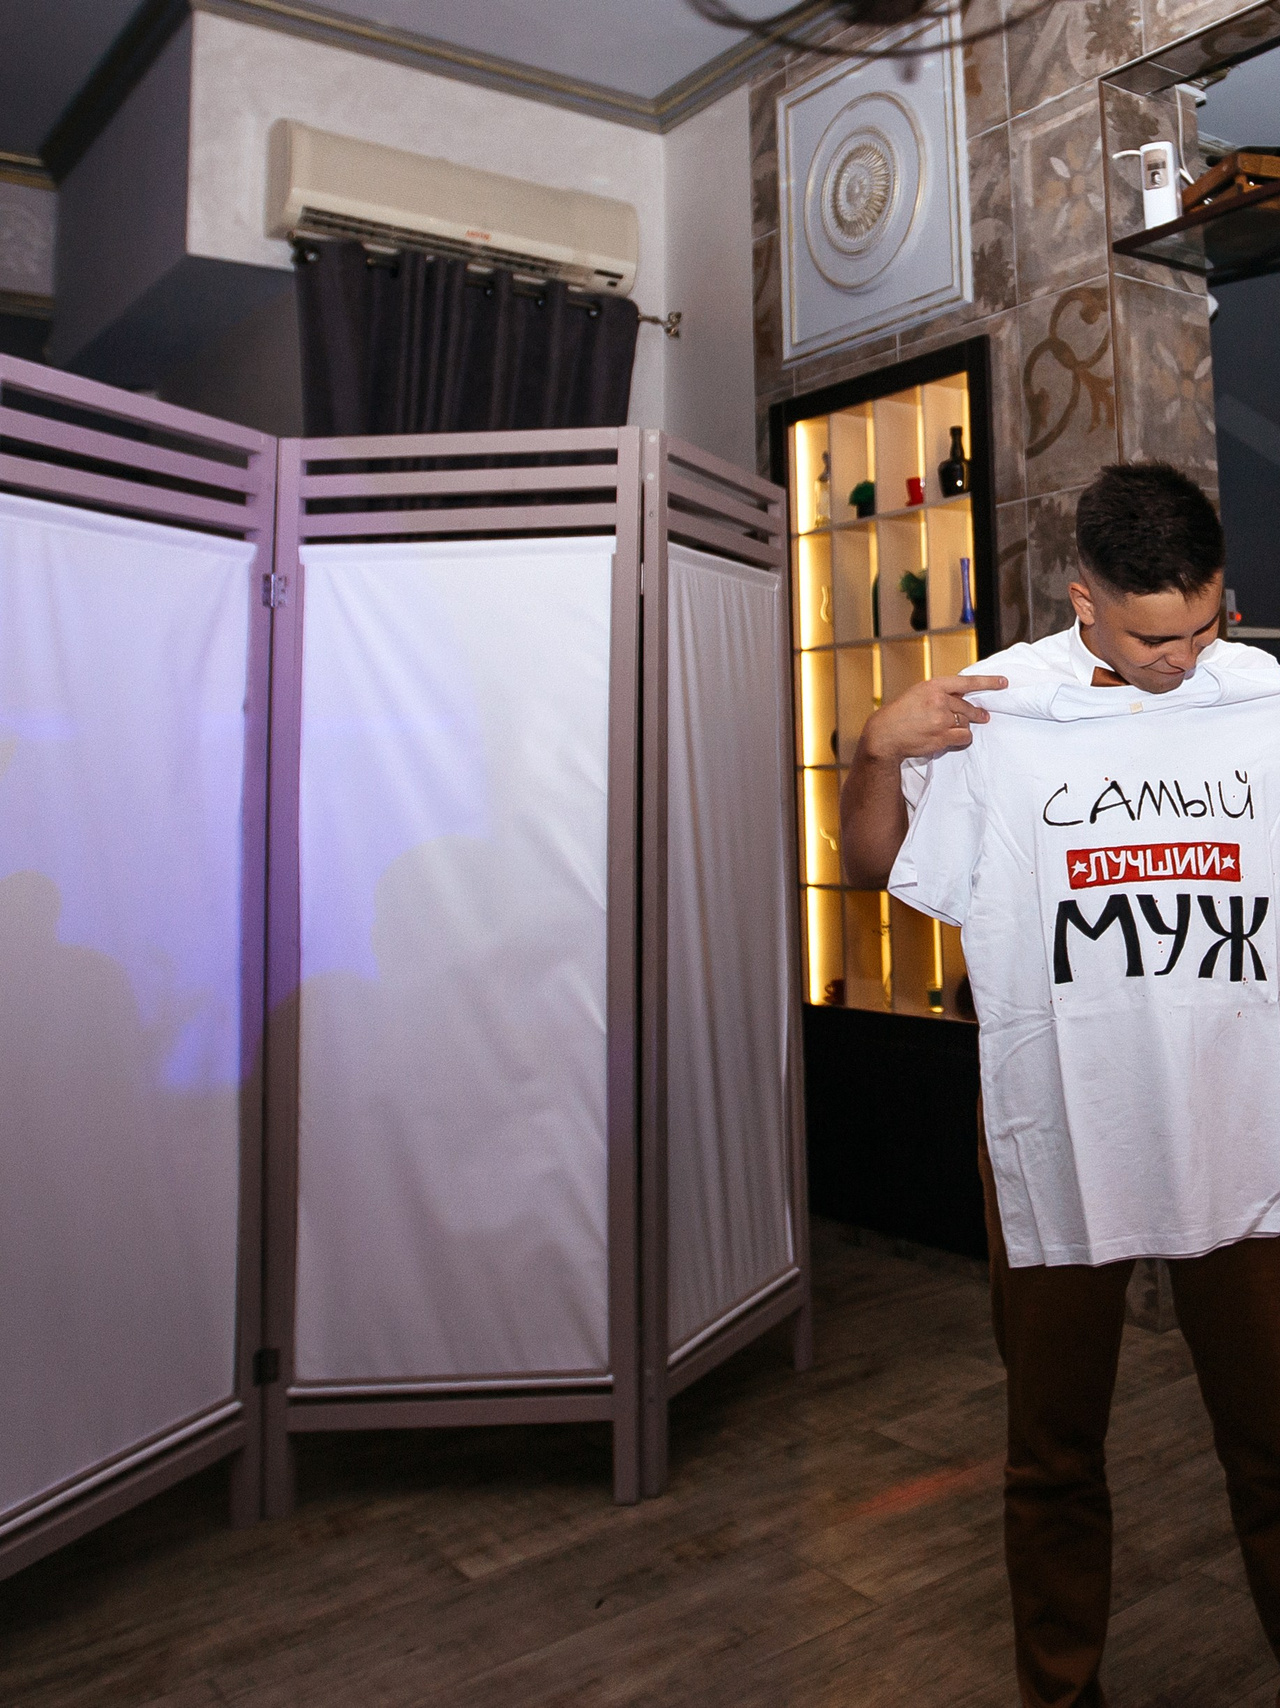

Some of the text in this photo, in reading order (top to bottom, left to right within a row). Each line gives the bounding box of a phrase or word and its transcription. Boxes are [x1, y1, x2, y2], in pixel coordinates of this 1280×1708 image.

[1042, 769, 1254, 826] САМЫЙ
[1085, 843, 1221, 883] ЛУЧШИЙ
[1053, 893, 1270, 984] МУЖ
